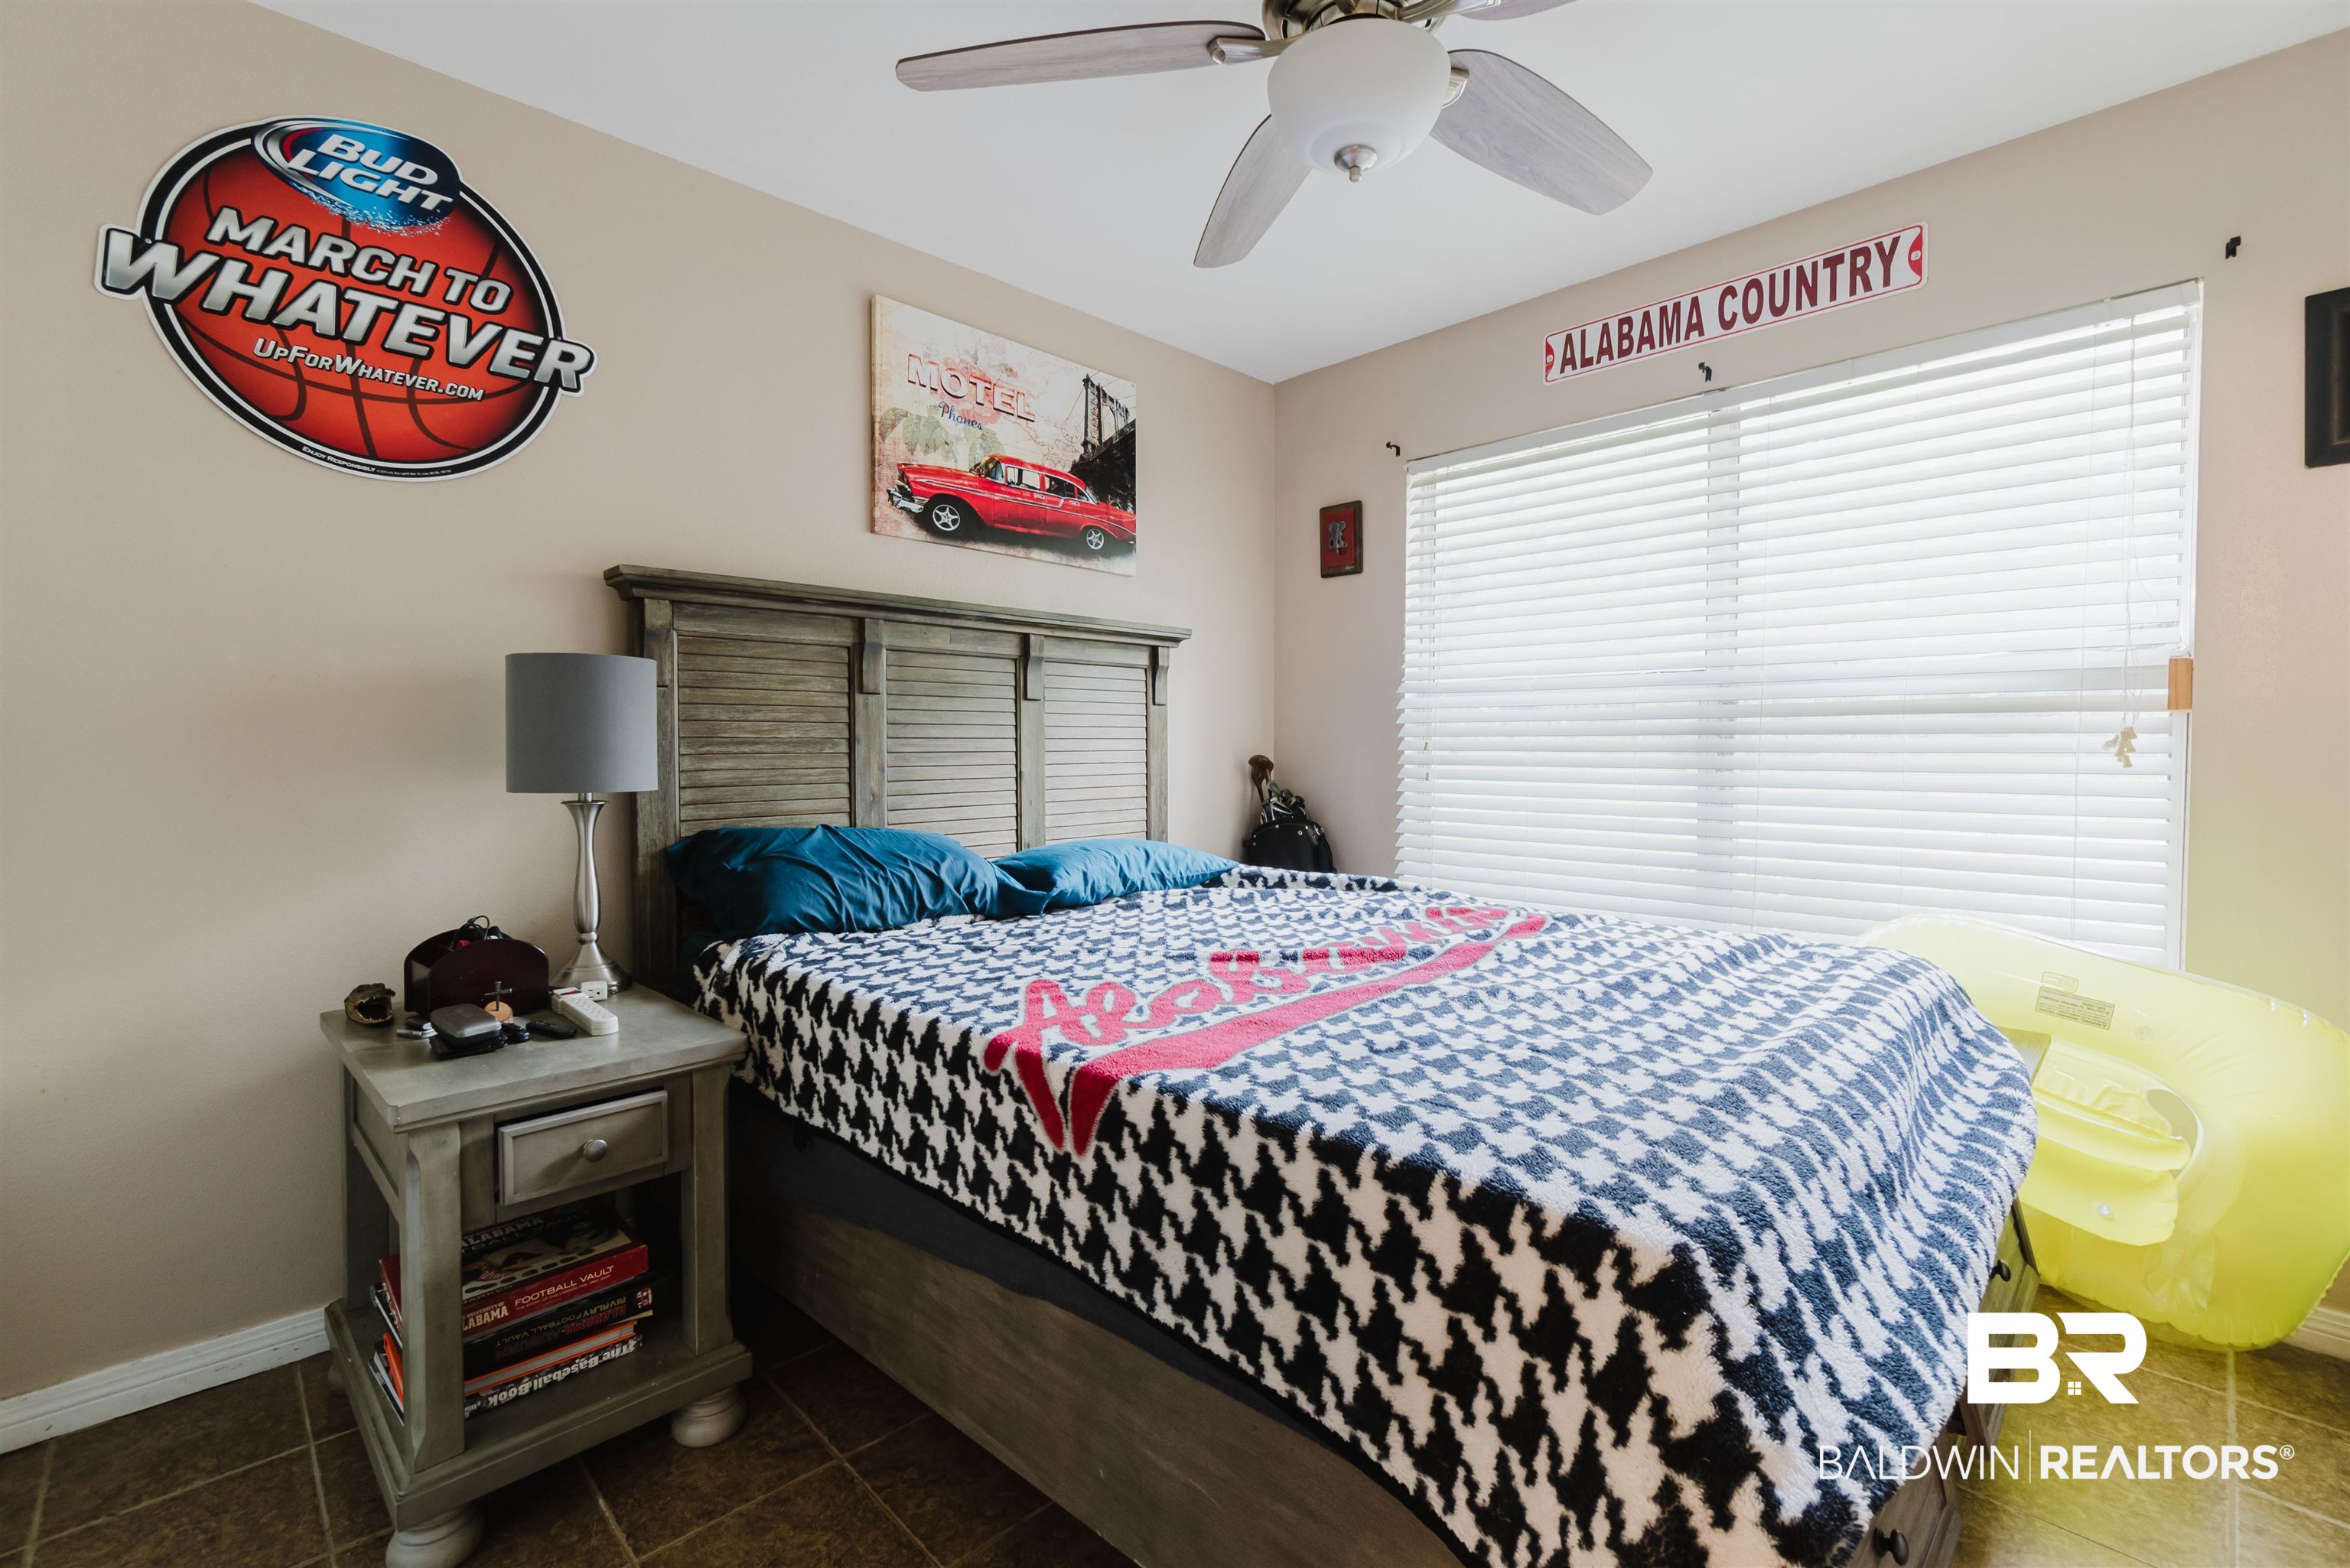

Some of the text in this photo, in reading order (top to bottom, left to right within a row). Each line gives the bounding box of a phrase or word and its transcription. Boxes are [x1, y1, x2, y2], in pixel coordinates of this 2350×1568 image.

[287, 148, 454, 210] LIGHT
[317, 134, 438, 185] BUD
[207, 207, 513, 313] MARCH TO
[105, 229, 592, 391] WHATEVER
[1559, 236, 1902, 375] ALABAMA COUNTRY
[253, 337, 484, 402] UPFORWHATEVER.COM
[907, 354, 1036, 422] MOTEL
[938, 401, 983, 431] Phones
[302, 445, 327, 460] ENJOY
[327, 454, 376, 472] RESPONSIBLY
[514, 1280, 578, 1307] FOOTBALL
[579, 1265, 615, 1283] VAULT
[462, 1305, 509, 1332] LABAMA
[495, 1297, 627, 1347] RIVALRY FOOTBALL VAULT
[487, 1344, 630, 1407] The Baseball Book
